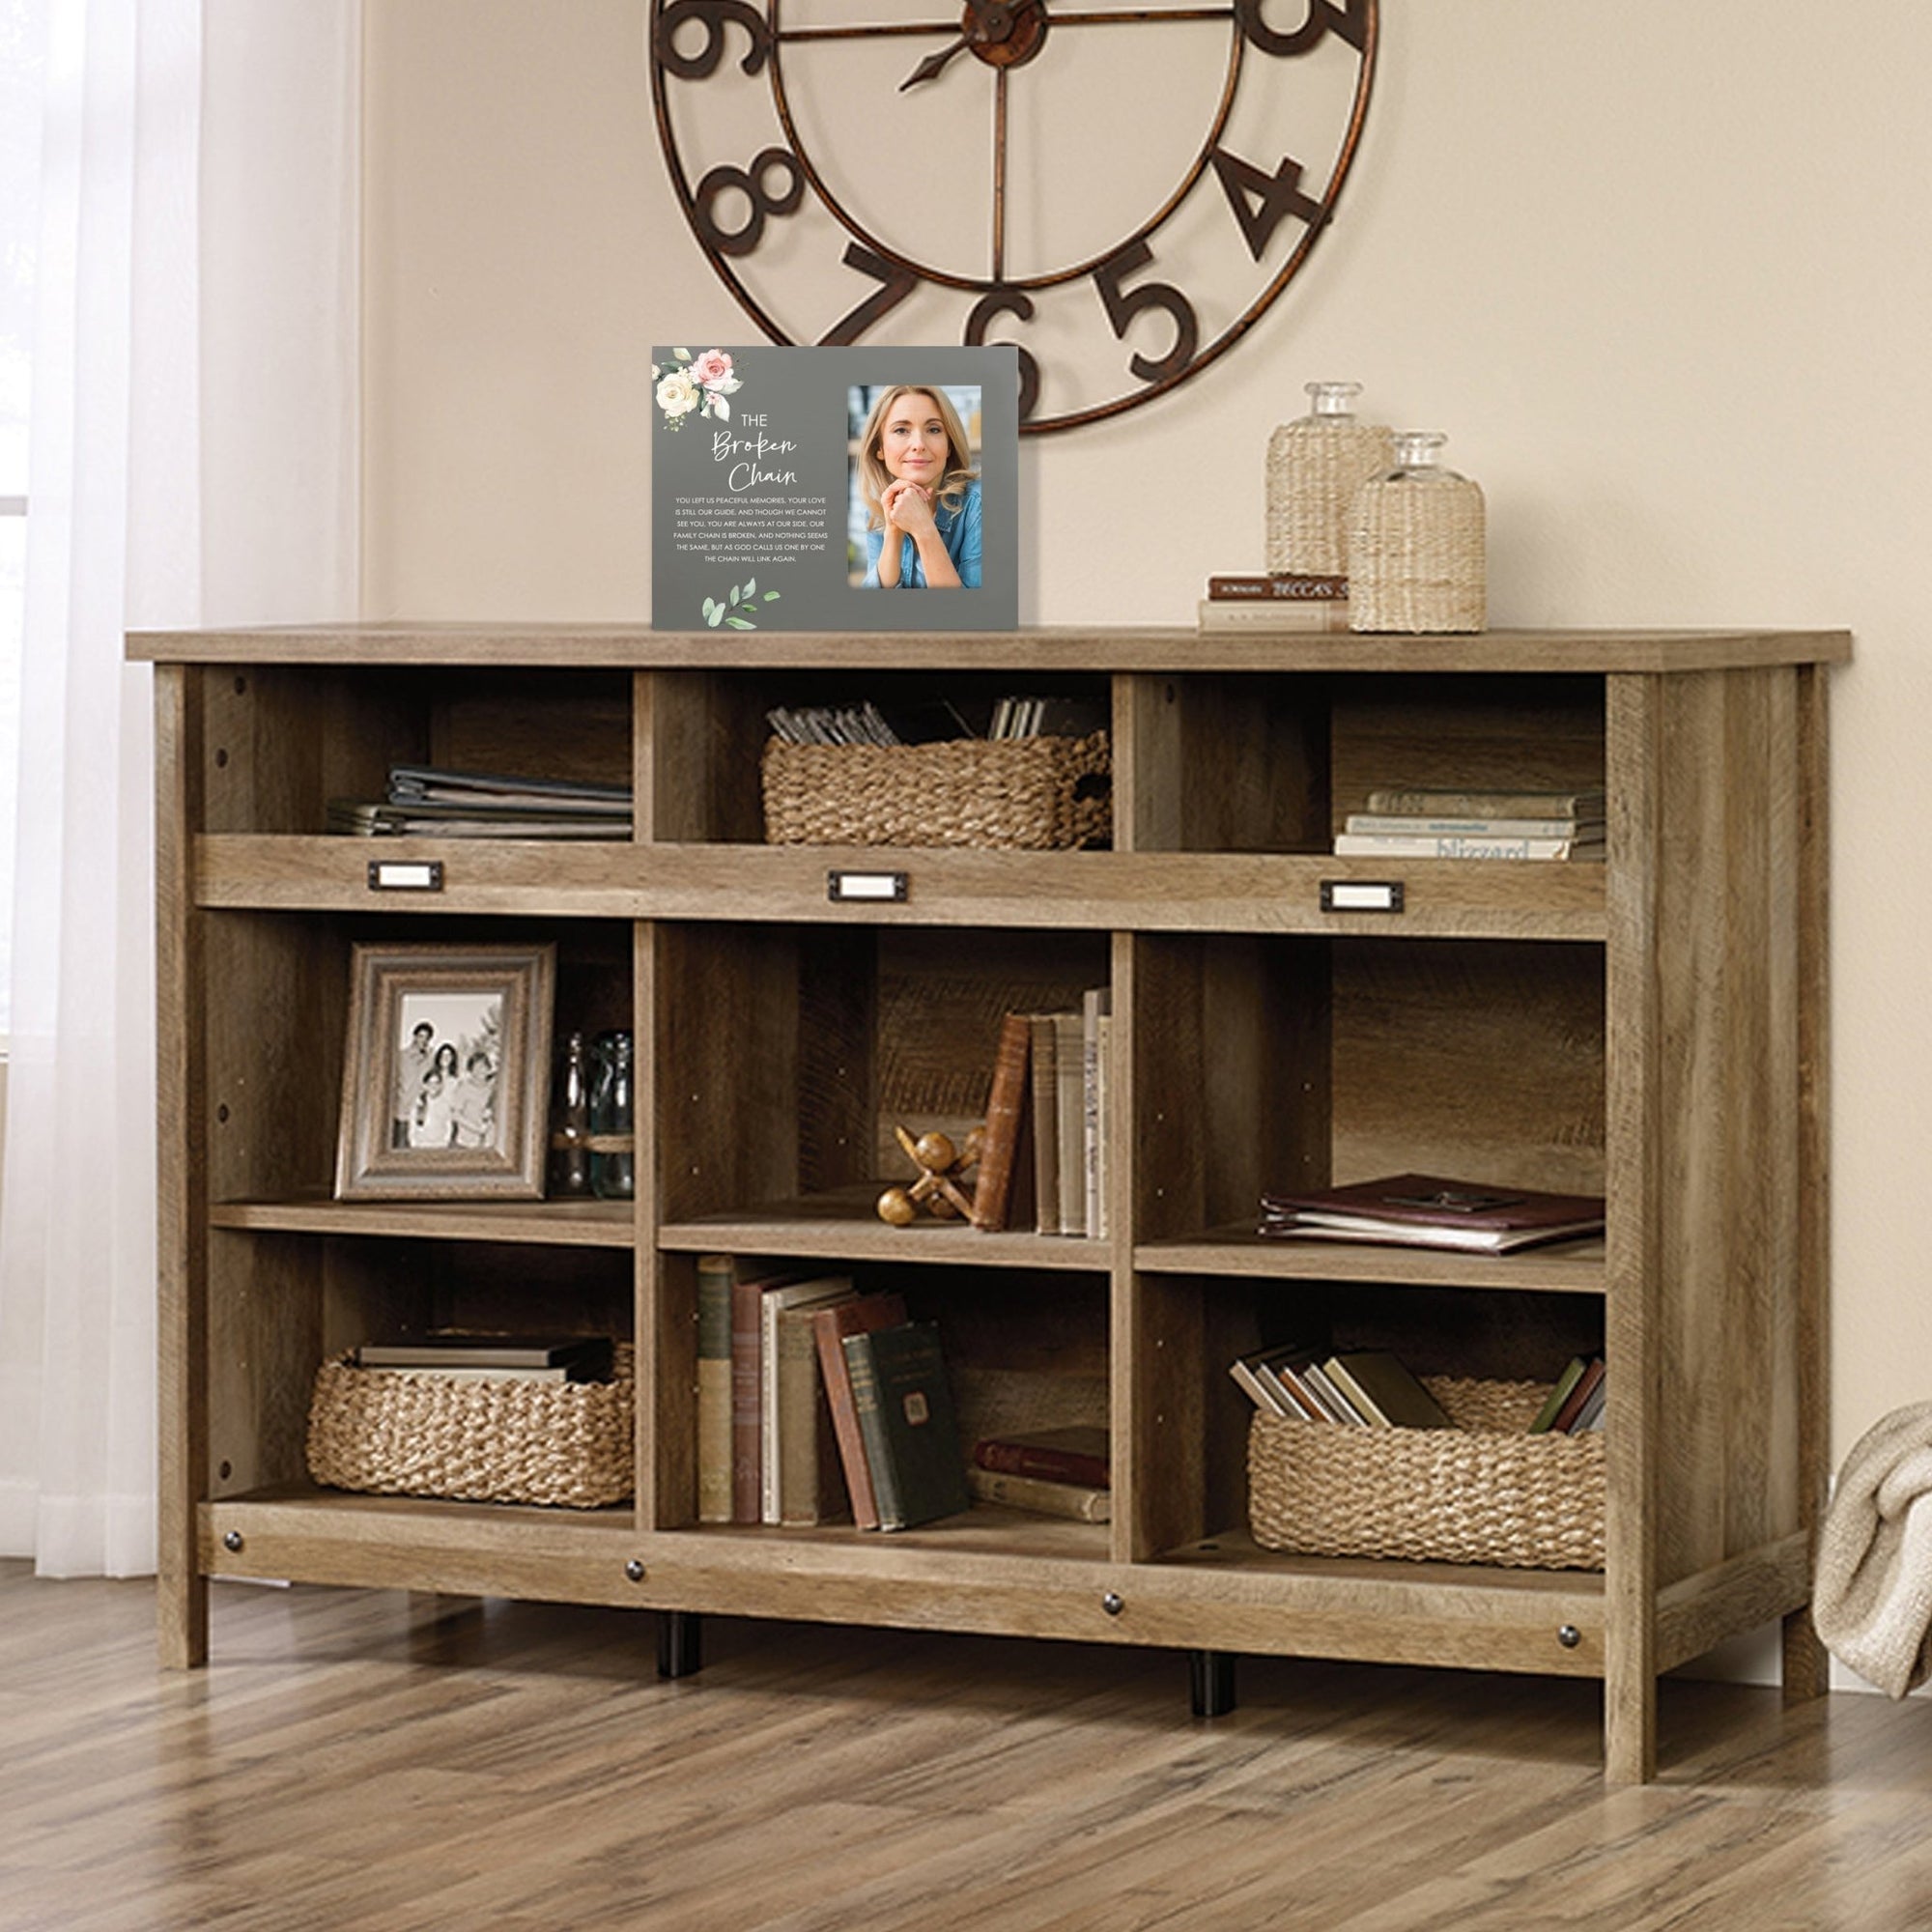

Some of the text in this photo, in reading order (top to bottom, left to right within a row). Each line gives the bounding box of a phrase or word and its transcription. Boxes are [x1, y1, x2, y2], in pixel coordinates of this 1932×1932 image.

[694, 147, 806, 258] 8
[1211, 147, 1331, 262] 4
[817, 241, 918, 346] 7
[1092, 238, 1199, 383] 5
[964, 289, 1040, 421] 6
[711, 430, 797, 462] Broken
[741, 413, 768, 427] THE
[675, 496, 690, 504] YOU
[691, 496, 704, 504] LEFT
[705, 496, 715, 504] US
[715, 496, 748, 504] PEACEFUL
[787, 496, 807, 504] YOUR
[808, 496, 826, 504] LOVE
[728, 462, 797, 493] Chain
[1436, 838, 1530, 860] blizzard
